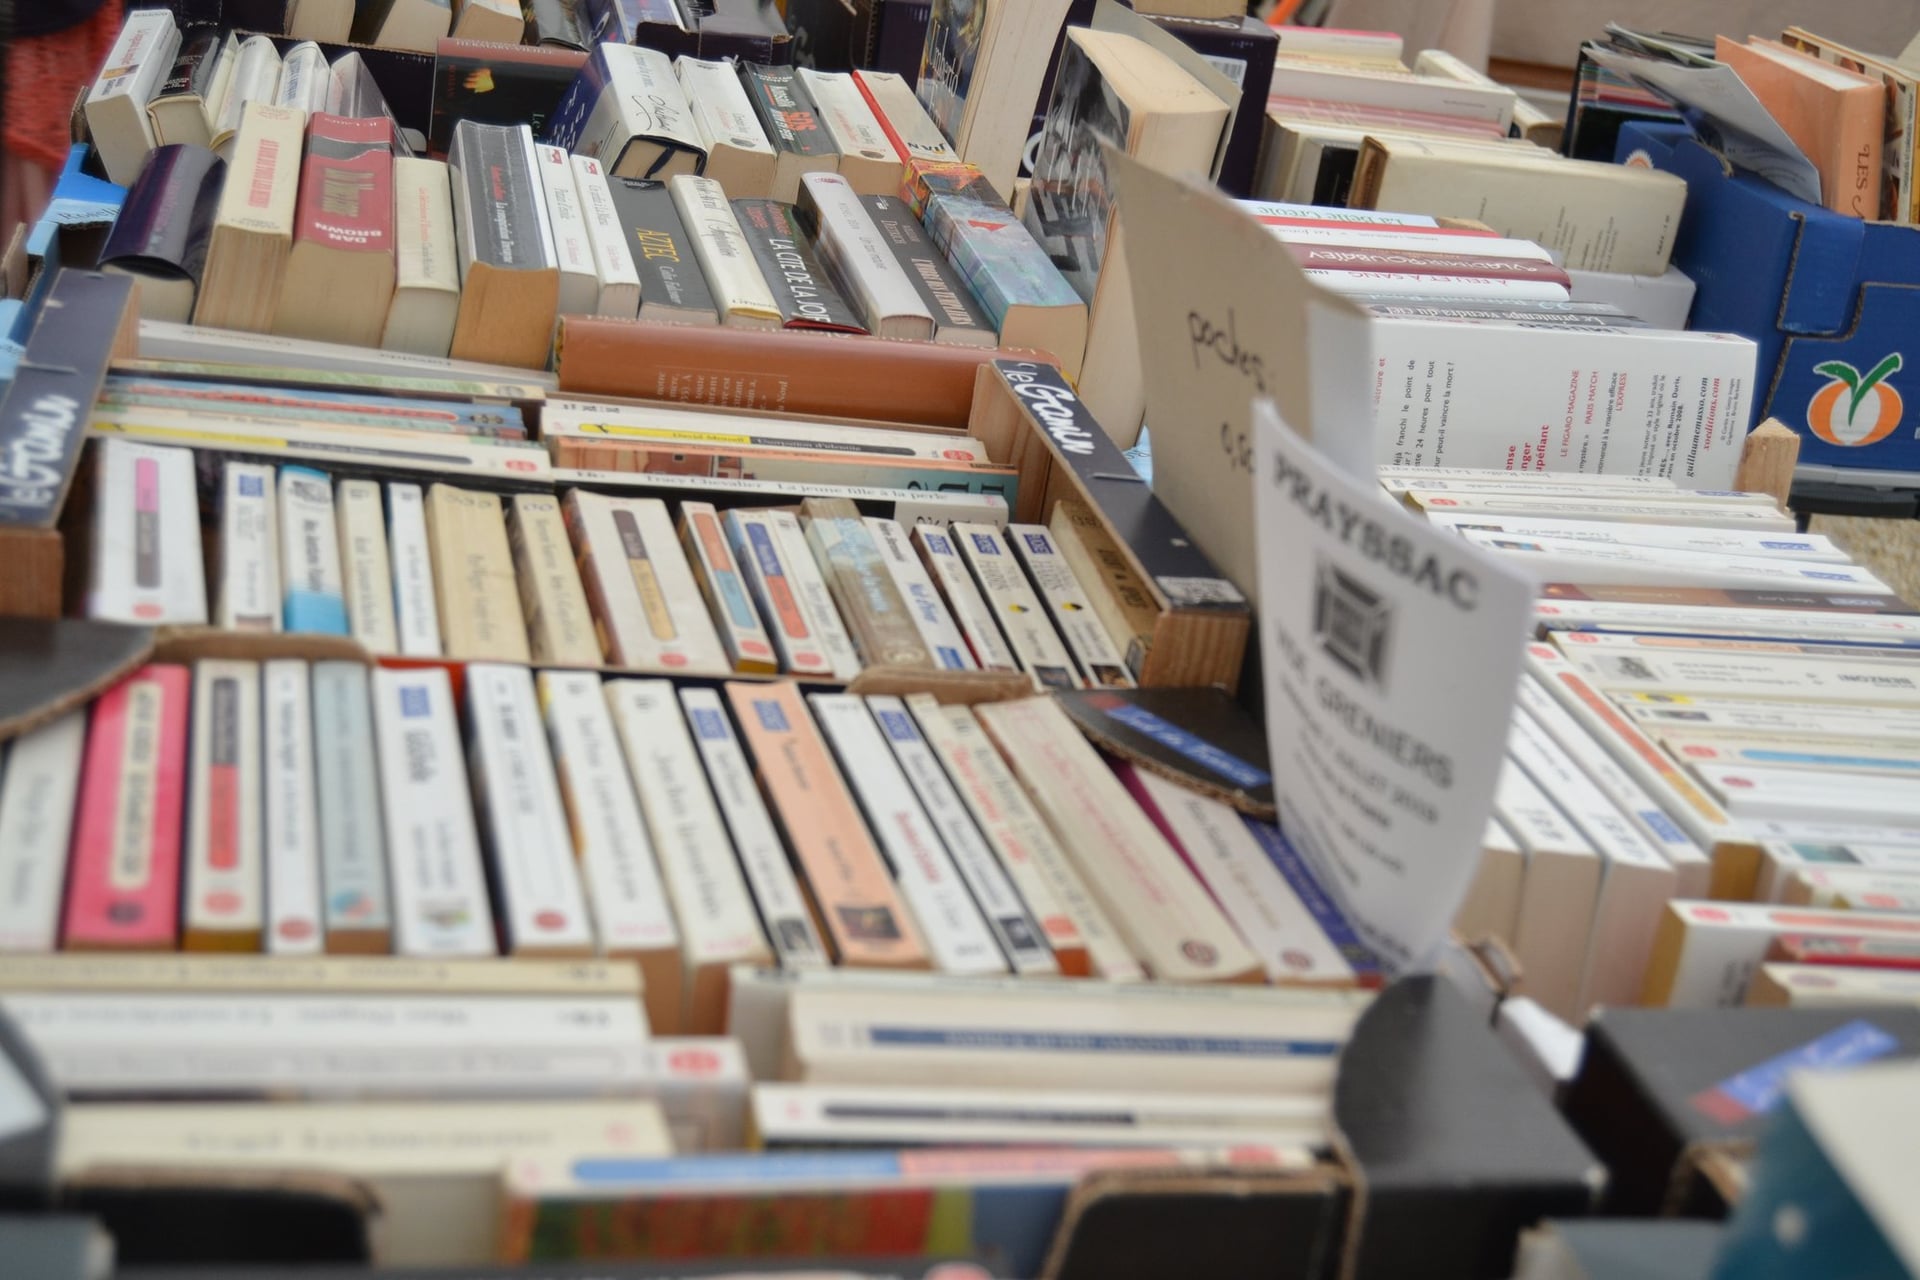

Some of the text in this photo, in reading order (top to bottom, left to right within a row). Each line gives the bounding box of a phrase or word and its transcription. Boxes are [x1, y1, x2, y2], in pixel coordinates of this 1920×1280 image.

[792, 109, 819, 132] SOS
[313, 221, 384, 240] BROWN
[326, 233, 369, 245] DAN
[635, 227, 680, 263] AZTEC
[769, 237, 787, 249] LA
[785, 270, 811, 284] DE
[792, 284, 814, 299] LA
[1386, 306, 1414, 315] ciel
[1418, 308, 1436, 317] du
[1442, 309, 1498, 319] viendra
[1503, 311, 1576, 324] printemps
[1406, 360, 1415, 370] de
[1426, 361, 1435, 378] tout
[1405, 377, 1413, 398] point
[1445, 368, 1454, 388] mort
[1608, 372, 1618, 398] efficace
[1424, 383, 1432, 402] pour
[1584, 372, 1598, 424] PARIS MATCH
[1616, 373, 1627, 411] L'EXPRESS
[1667, 401, 1677, 428] Romain
[1672, 376, 1681, 398] Duris,
[1014, 380, 1094, 455] Gamin
[1419, 408, 1428, 433] heures
[1440, 399, 1450, 426] vaincre
[1560, 370, 1579, 457] LE FIGARO MAGAZINE
[1605, 399, 1614, 426] manière
[1675, 404, 1684, 421] 2008.
[1703, 378, 1720, 451] xoeditions.com
[1396, 418, 1407, 445] franchi
[1671, 424, 1681, 451] octobre
[1686, 378, 1708, 478] guillaumemusso.com
[1416, 439, 1424, 448] 24
[1435, 429, 1446, 453] peut-il
[1521, 443, 1532, 470] nger
[1670, 453, 1675, 461] en
[689, 477, 761, 491] Chevalier
[802, 484, 839, 496] jeune
[847, 486, 874, 496] fille
[1273, 449, 1481, 613] PRAYSSAC
